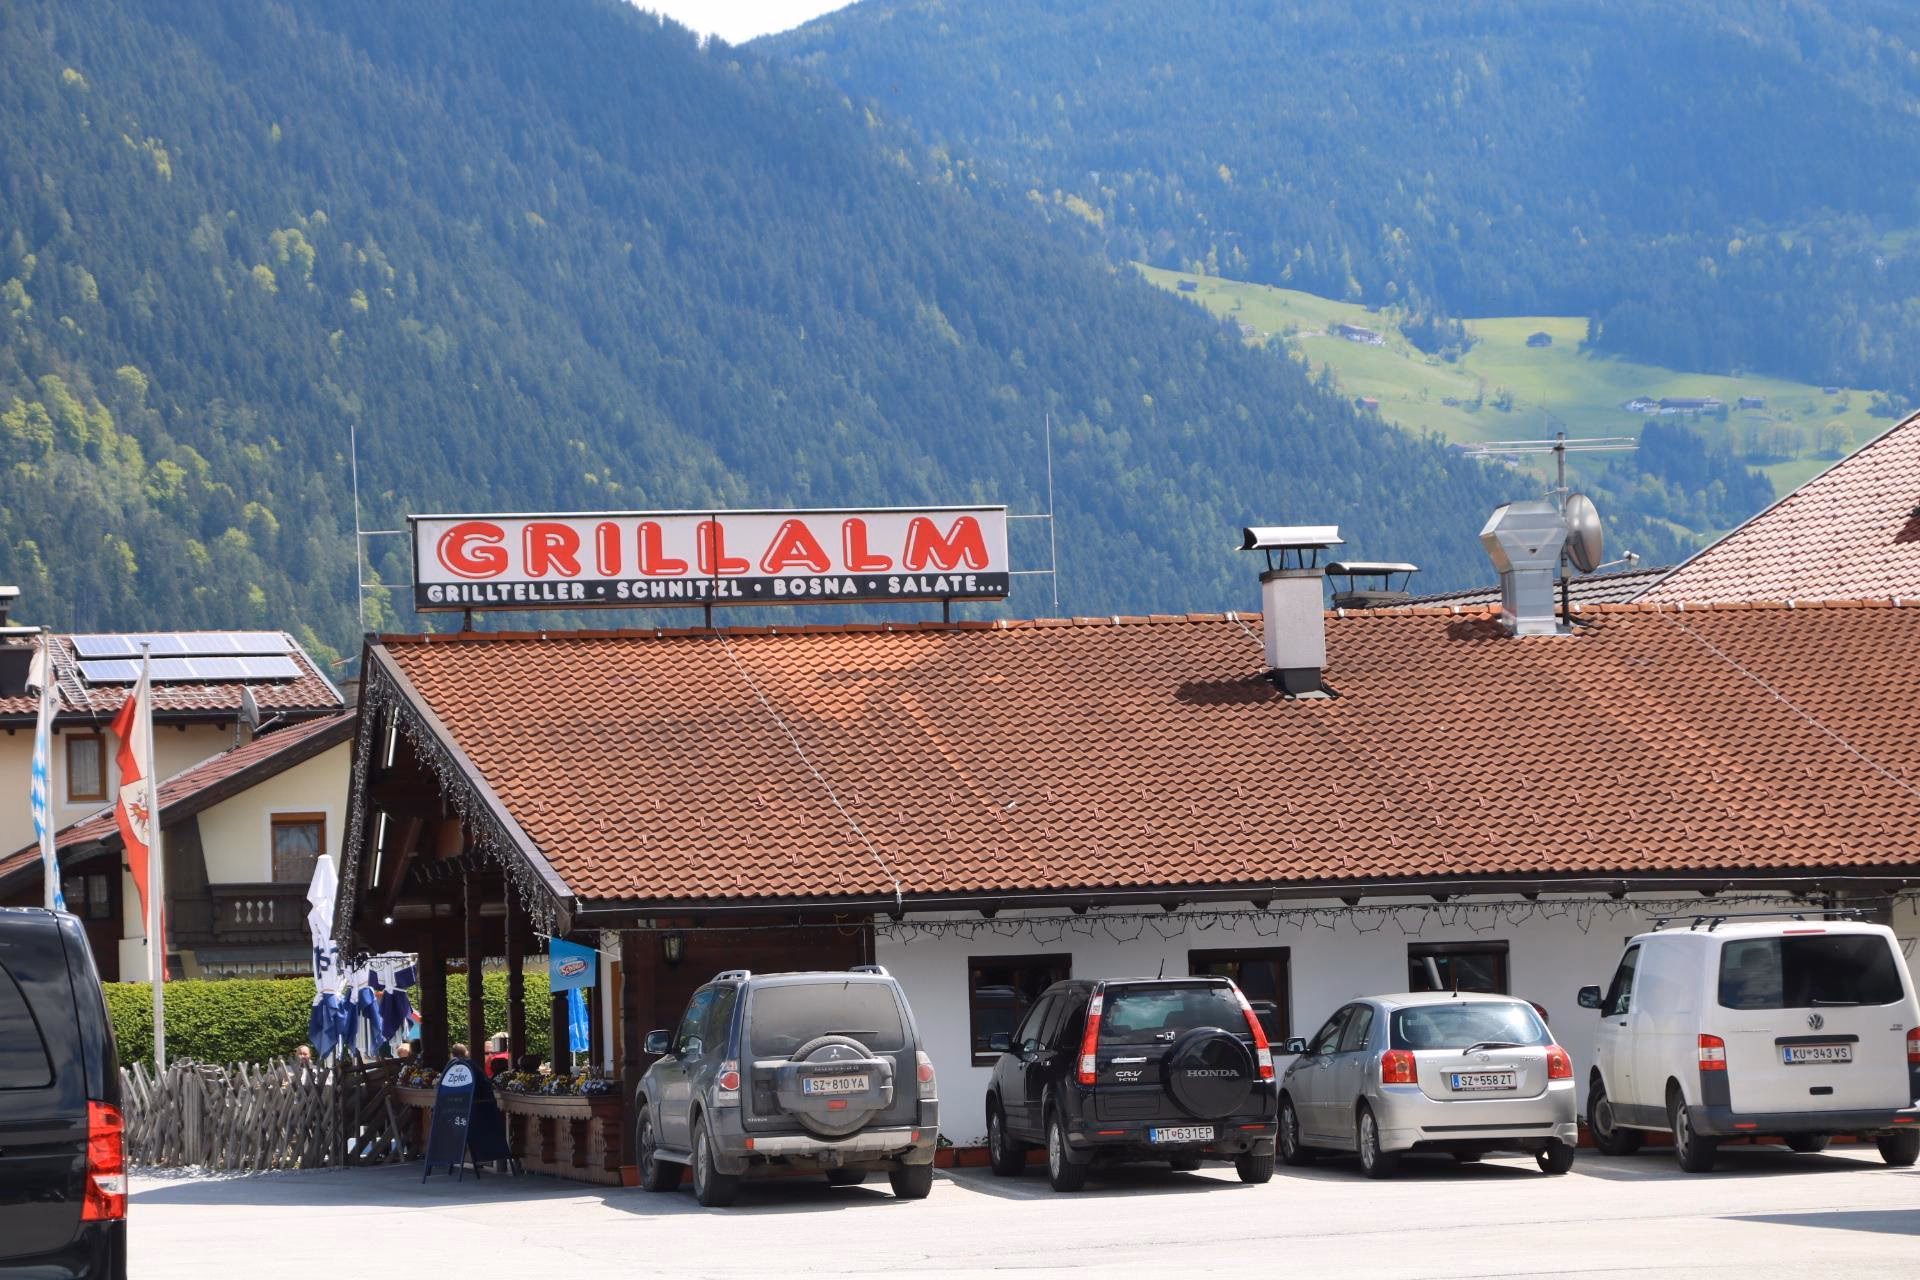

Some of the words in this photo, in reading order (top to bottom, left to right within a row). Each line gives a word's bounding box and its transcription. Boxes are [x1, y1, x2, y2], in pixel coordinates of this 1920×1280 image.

[436, 516, 989, 579] GRILLALM
[427, 582, 585, 602] GRILLTELLER
[617, 580, 743, 600] SCHNITZL
[774, 577, 857, 596] BOSNA
[1792, 1048, 1806, 1060] KU
[1813, 1048, 1832, 1059] 343
[1186, 1069, 1240, 1077] HONDA
[813, 1080, 825, 1091] SZ
[832, 1078, 850, 1090] 810
[852, 1077, 865, 1088] YA
[1461, 1075, 1474, 1086] SZ
[1480, 1075, 1499, 1086] 558
[1501, 1074, 1512, 1085] ZT
[1157, 1129, 1171, 1140] MT
[1177, 1127, 1213, 1140] 631EP
